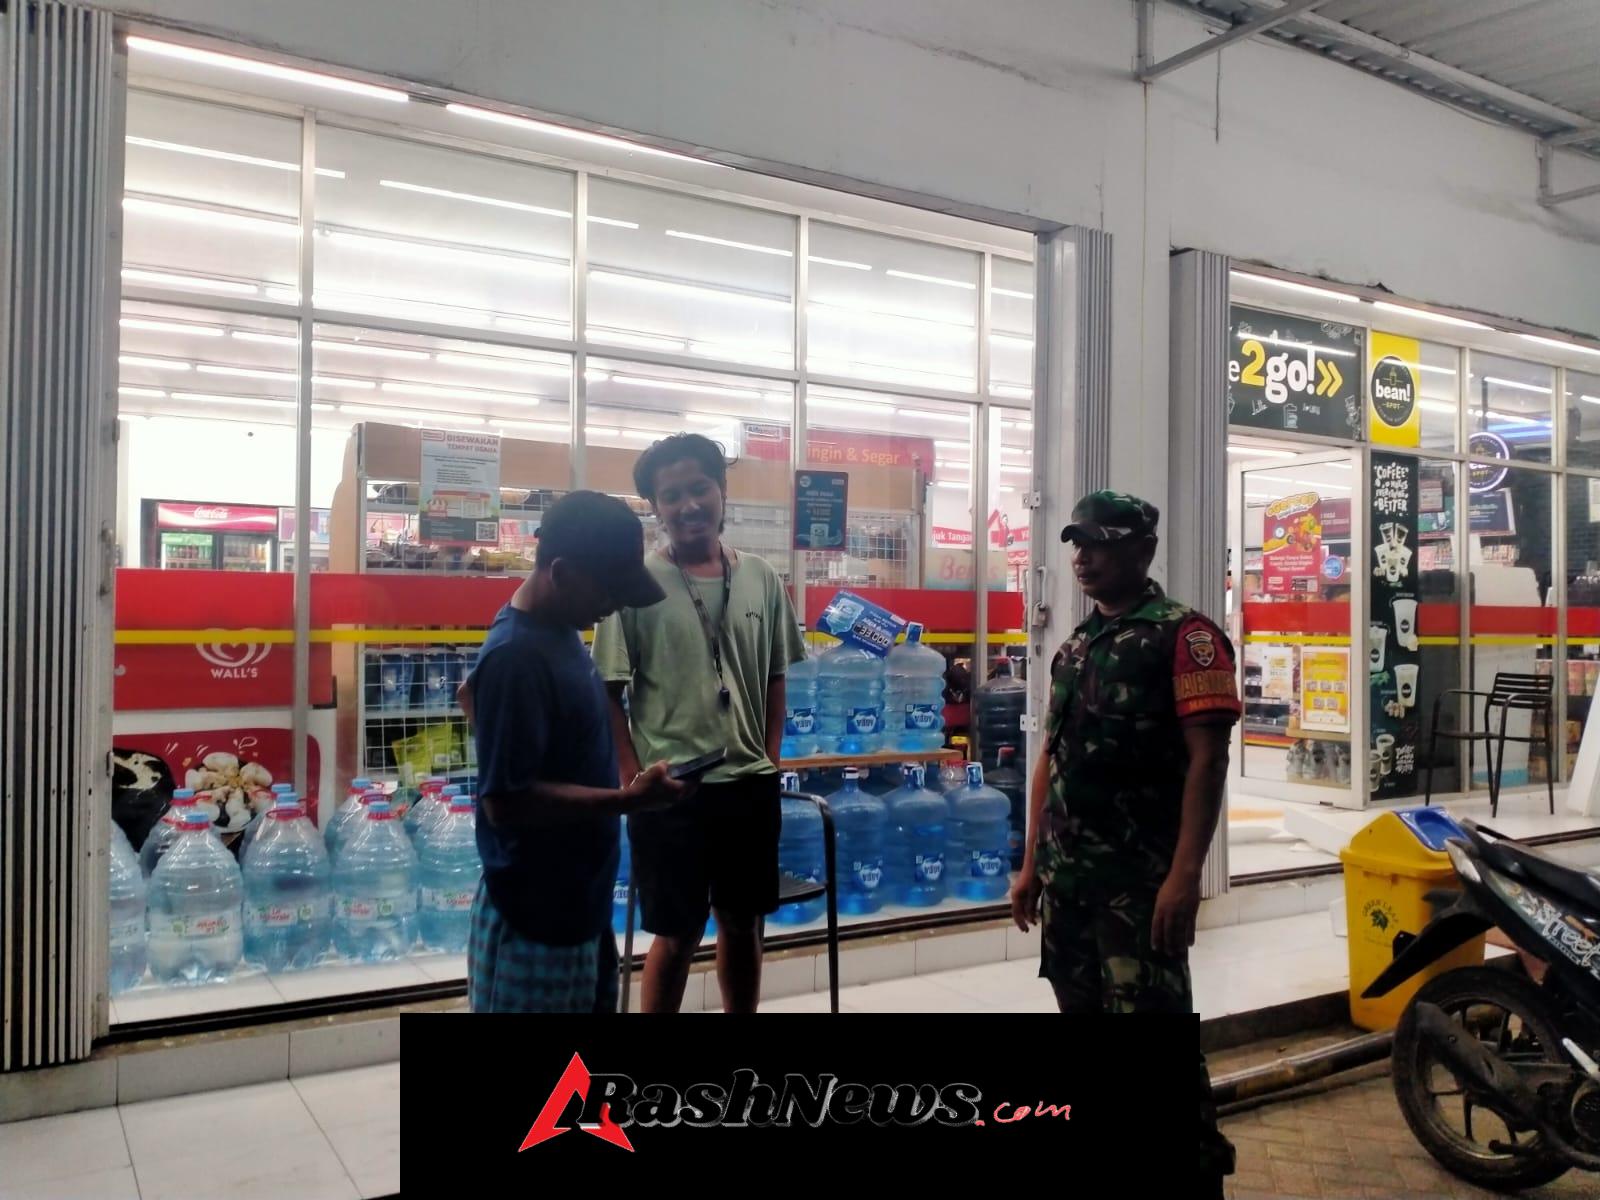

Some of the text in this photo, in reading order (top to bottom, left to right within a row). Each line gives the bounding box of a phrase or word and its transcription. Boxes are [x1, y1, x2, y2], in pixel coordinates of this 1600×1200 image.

[1375, 379, 1410, 402] bean!
[1386, 402, 1400, 410] SPOT
[446, 434, 498, 446] DISEWAKAN
[808, 447, 900, 465] ingin & Segar
[1376, 465, 1406, 479] COFFEE
[1378, 497, 1407, 512] BETTER
[948, 531, 973, 544] Tanga
[210, 667, 258, 679] WALL'S
